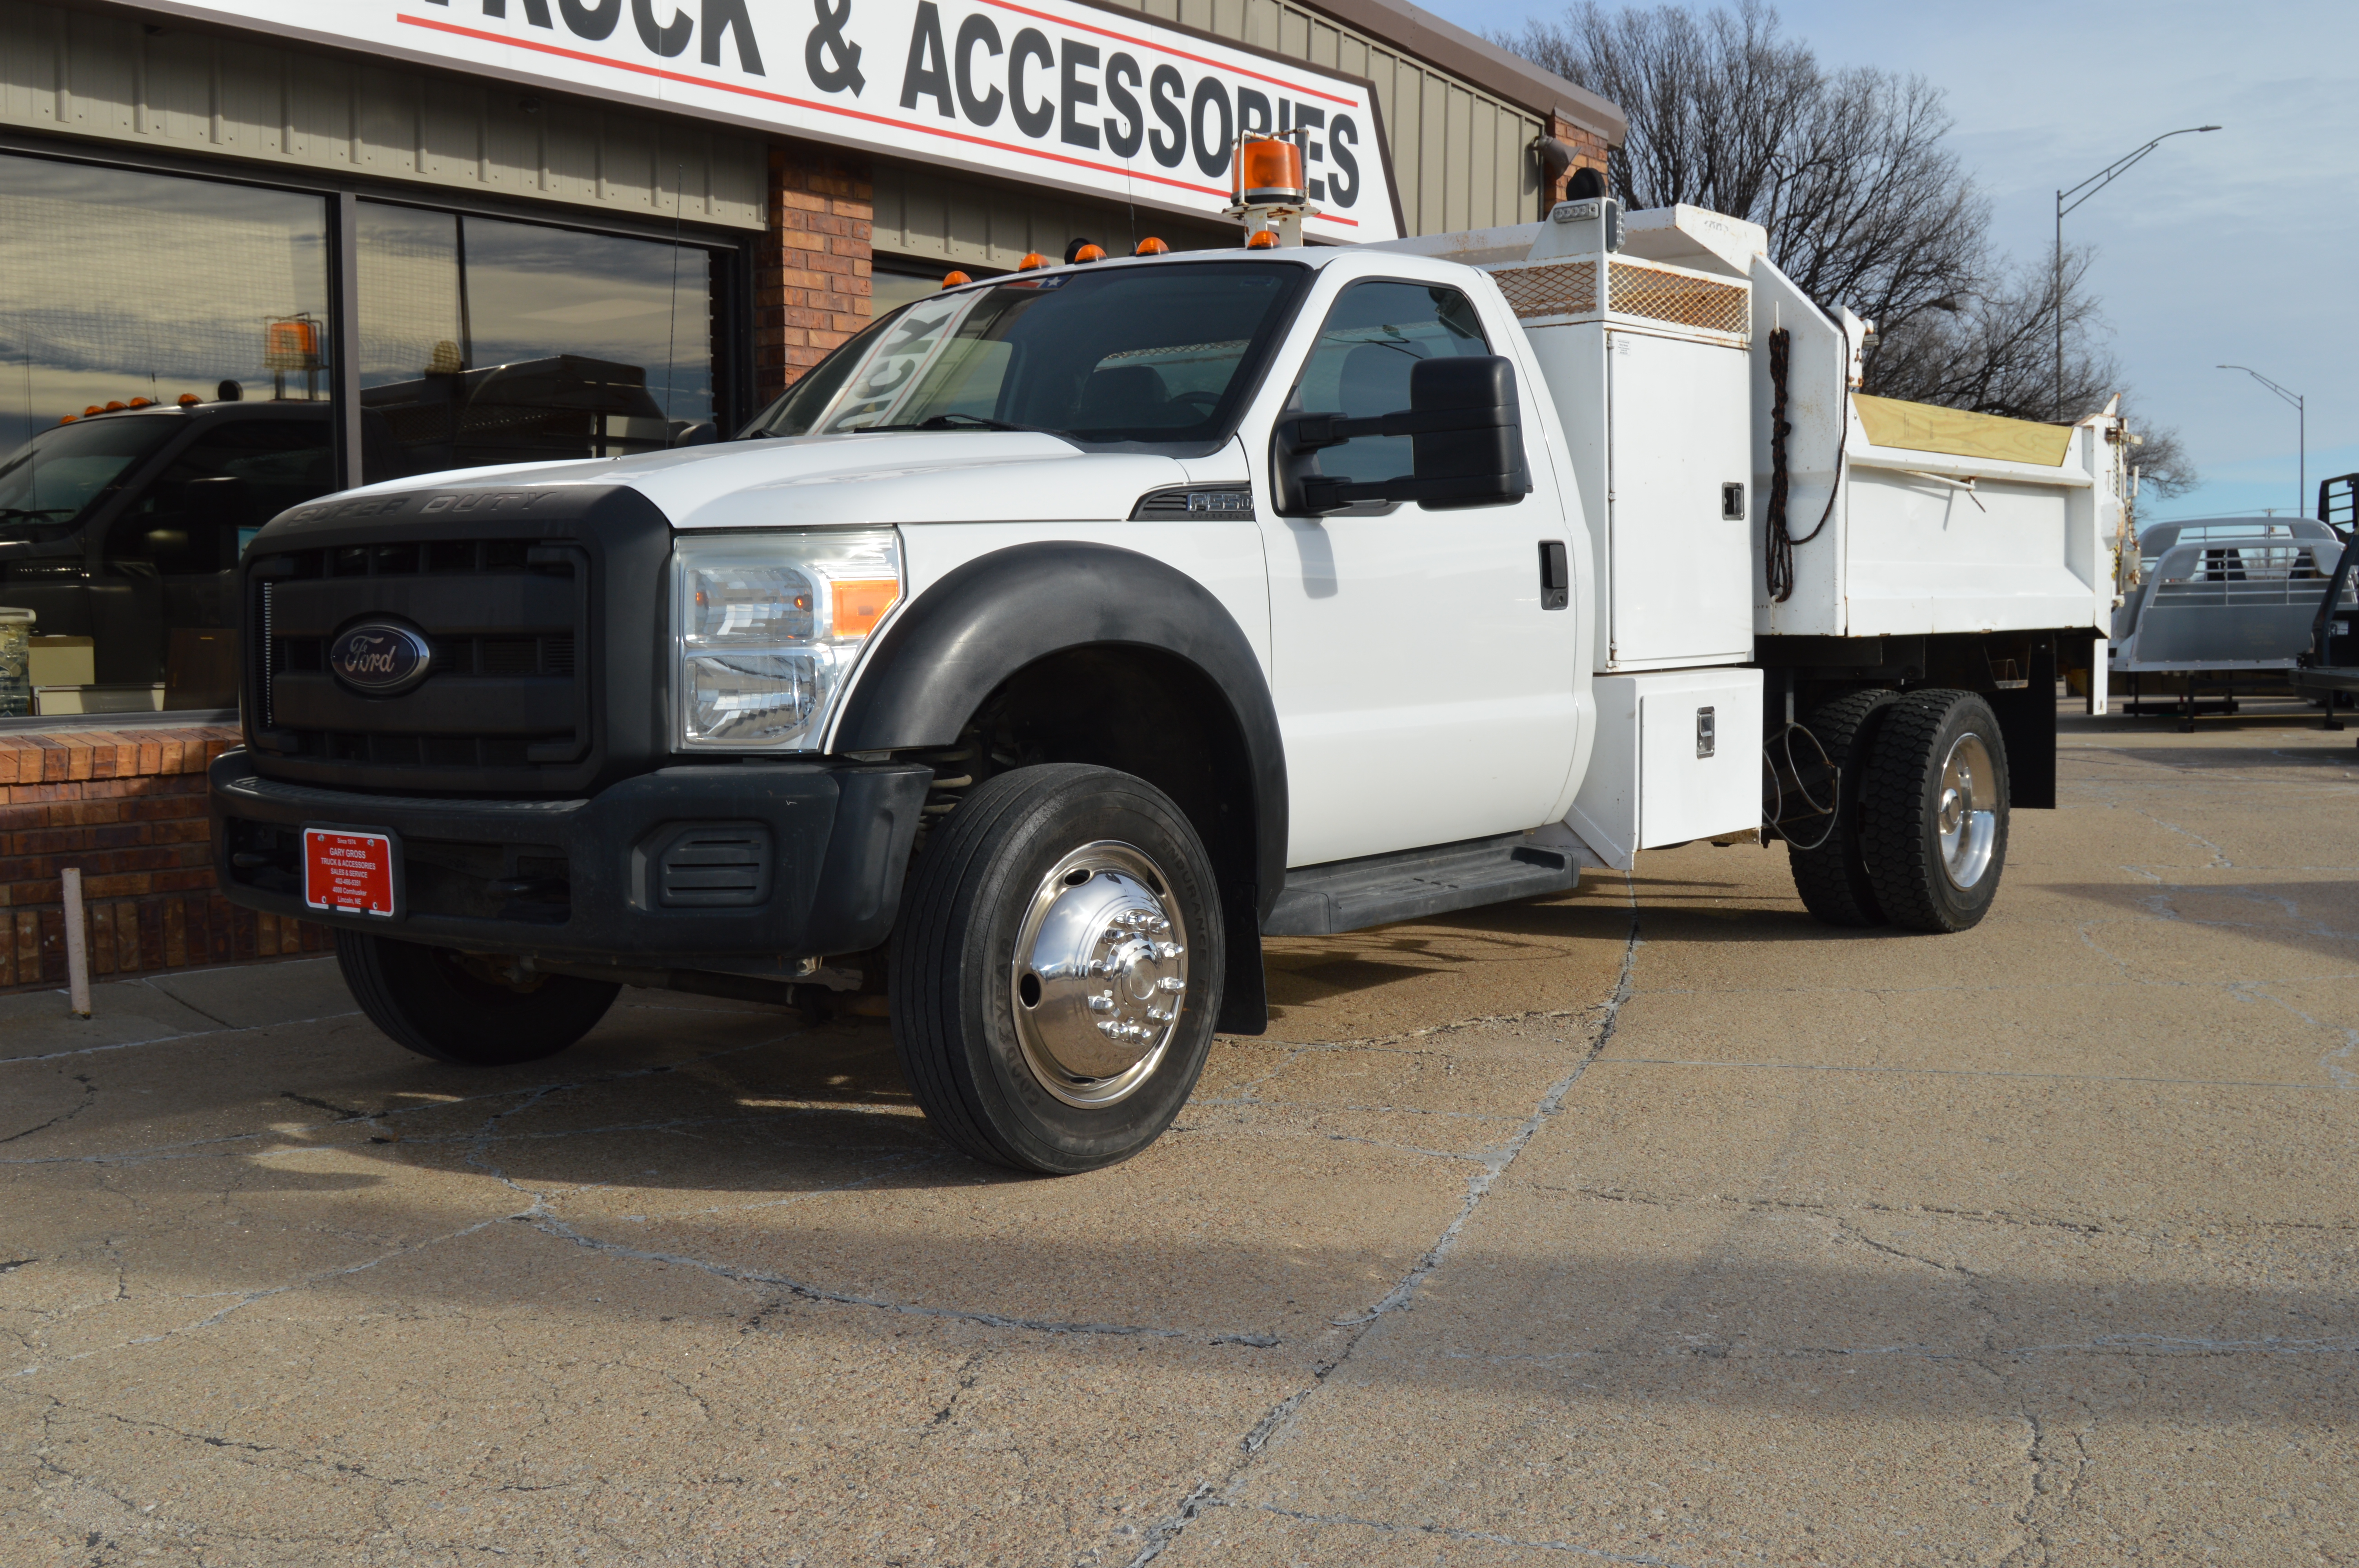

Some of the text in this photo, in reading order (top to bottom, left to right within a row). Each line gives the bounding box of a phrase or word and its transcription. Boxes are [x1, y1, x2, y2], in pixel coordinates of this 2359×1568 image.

[805, 0, 866, 98] &
[287, 491, 559, 527] SUPER DUTY
[1187, 493, 1253, 512] F550
[344, 635, 397, 673] Ford
[330, 848, 366, 859] GARY GROSS
[321, 857, 337, 866] TRUCK
[342, 860, 376, 870] ACCESSORIES
[338, 896, 354, 905] Lincoln,
[343, 887, 367, 896] Cornhusker
[996, 937, 1041, 1107] GOODYEAR
